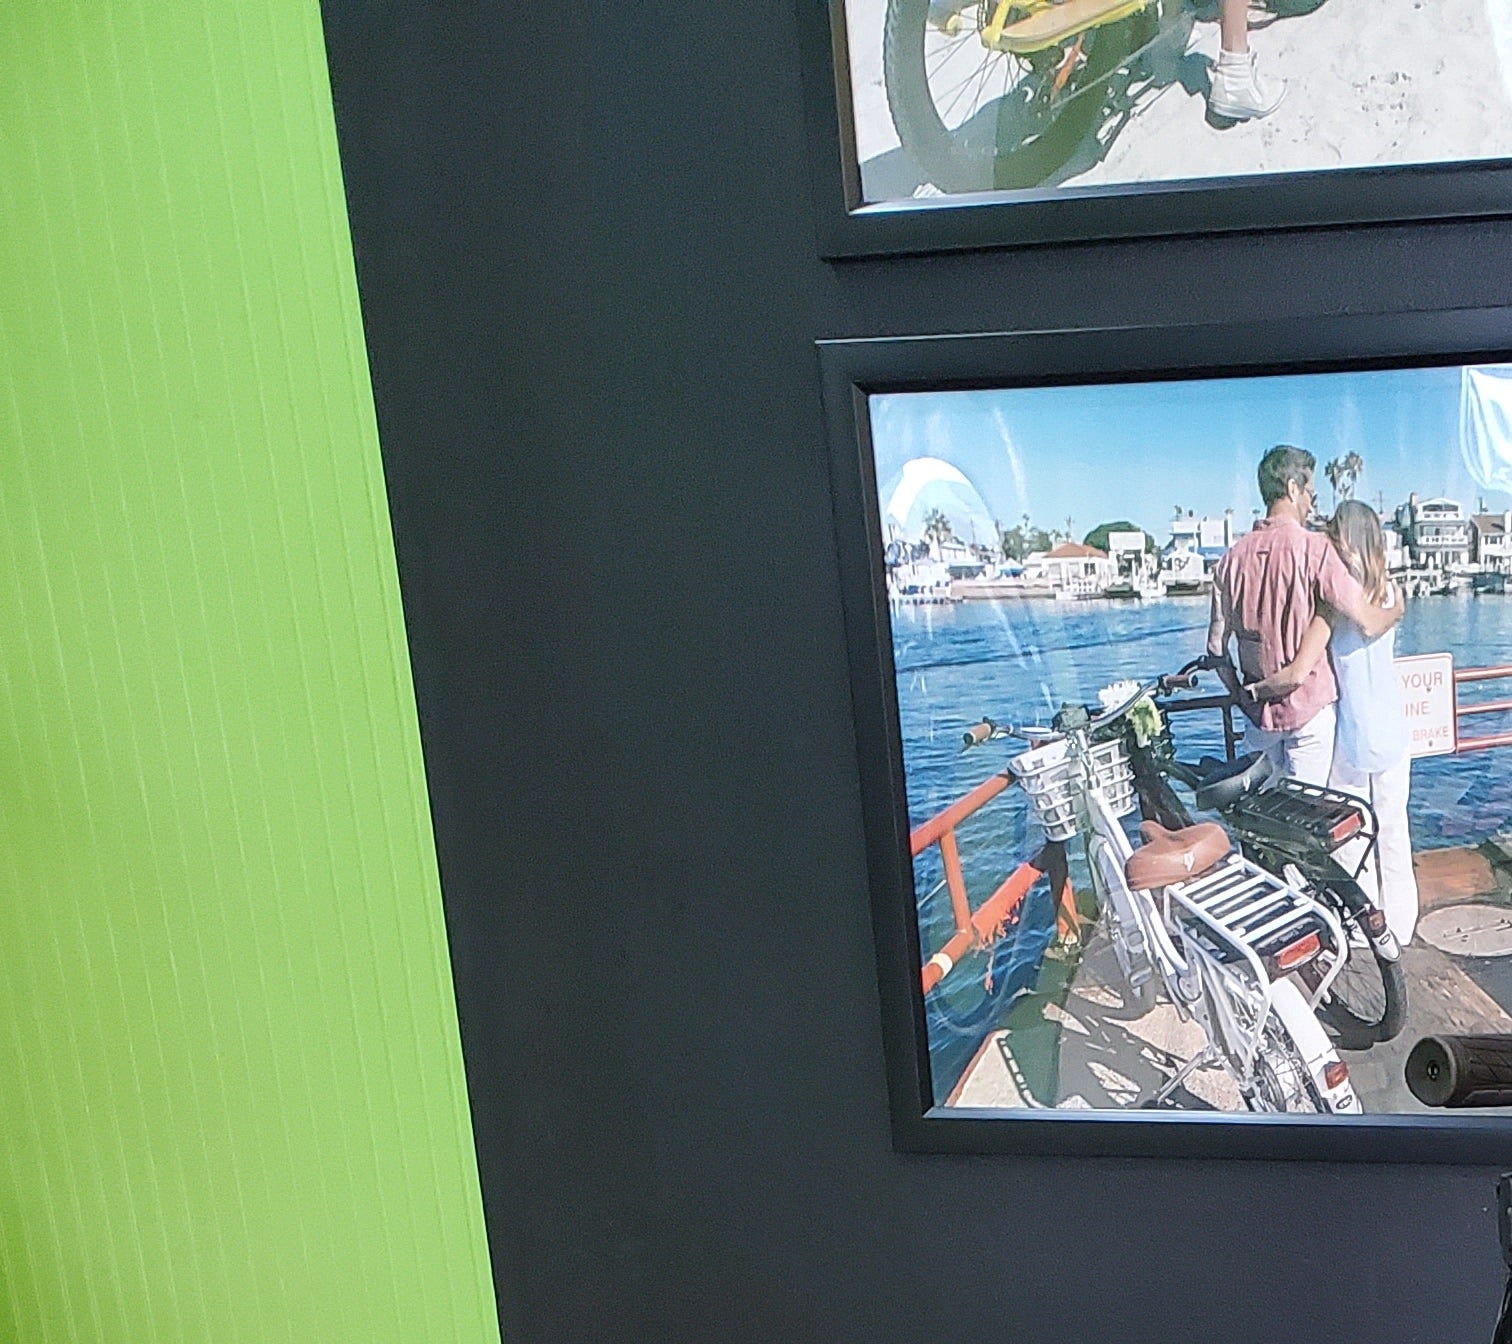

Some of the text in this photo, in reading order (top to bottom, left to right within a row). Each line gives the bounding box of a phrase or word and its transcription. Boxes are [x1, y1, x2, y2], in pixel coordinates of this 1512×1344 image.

[1402, 672, 1442, 688] YOUR
[1405, 701, 1430, 717] INE
[1412, 726, 1449, 741] BRAKE
